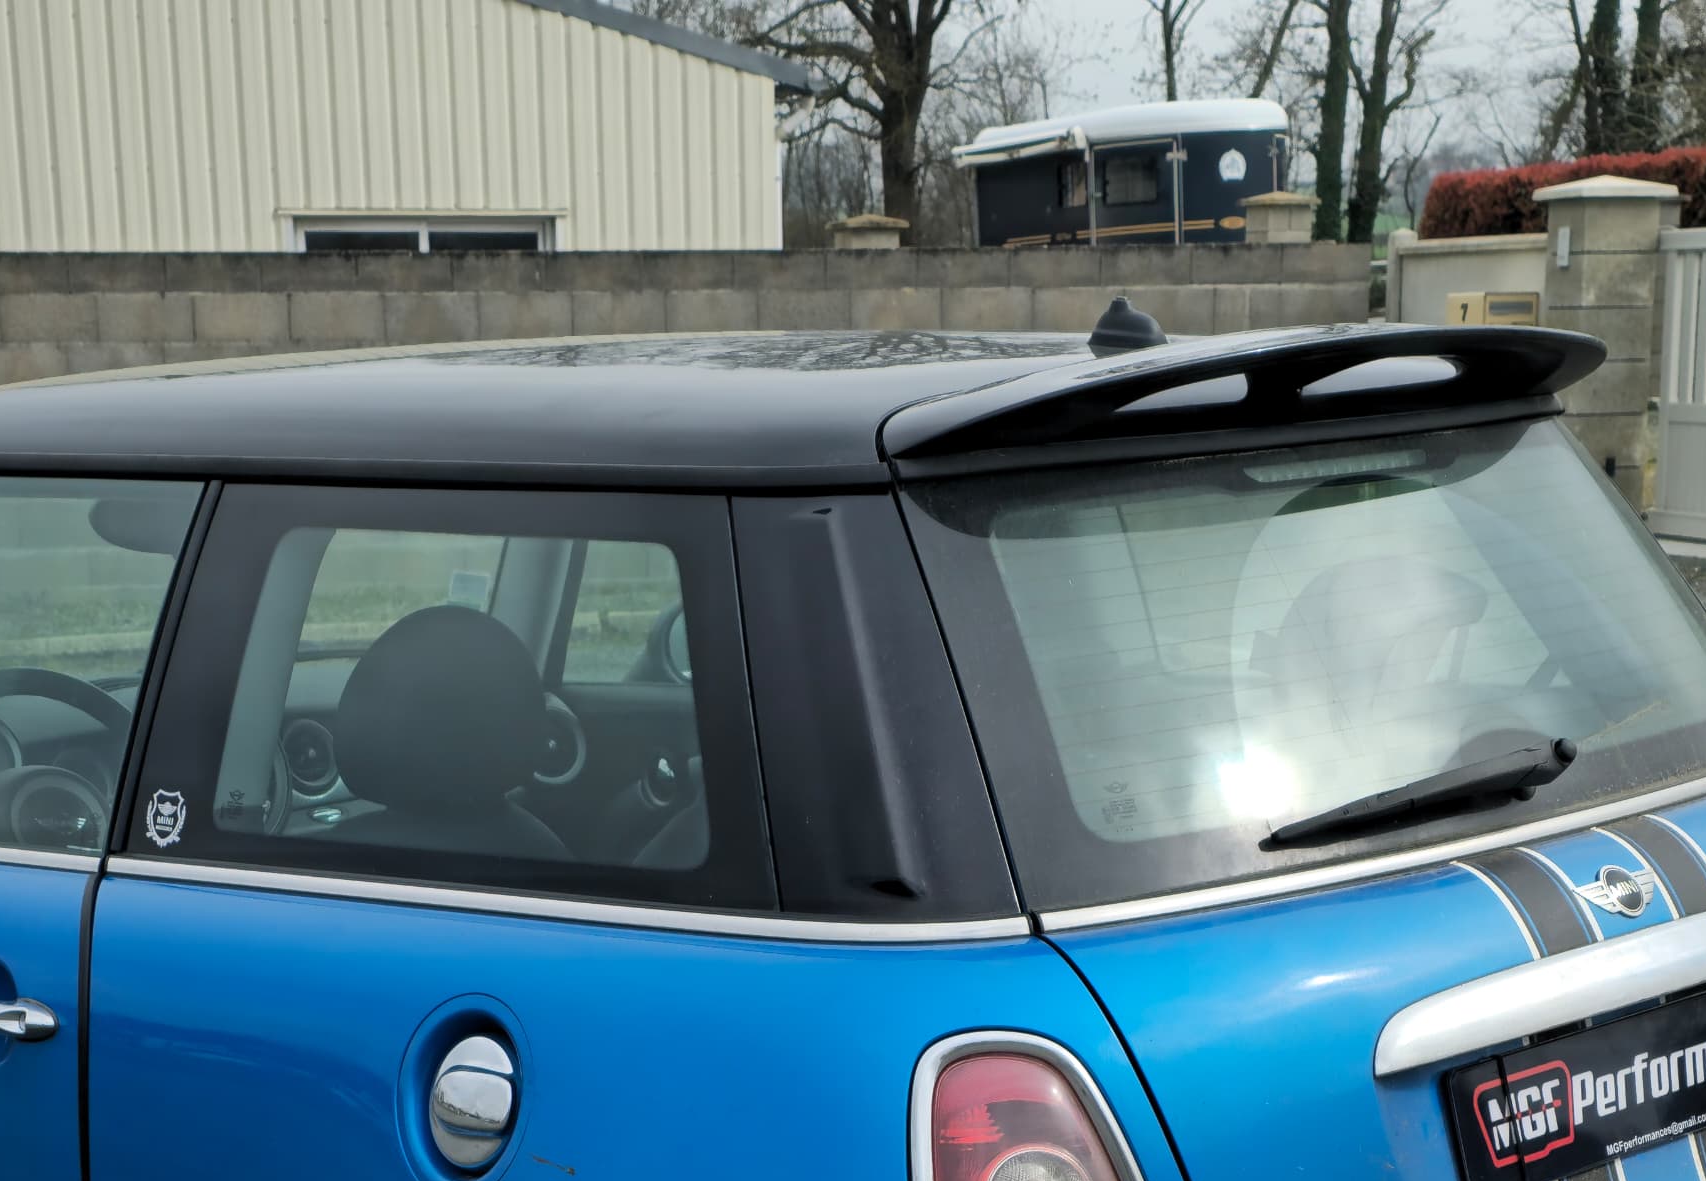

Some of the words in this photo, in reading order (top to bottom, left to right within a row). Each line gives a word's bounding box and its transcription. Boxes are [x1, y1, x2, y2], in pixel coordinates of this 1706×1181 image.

[156, 815, 174, 825] MINI
[1609, 879, 1639, 898] MINI
[1487, 1078, 1561, 1151] MGF
